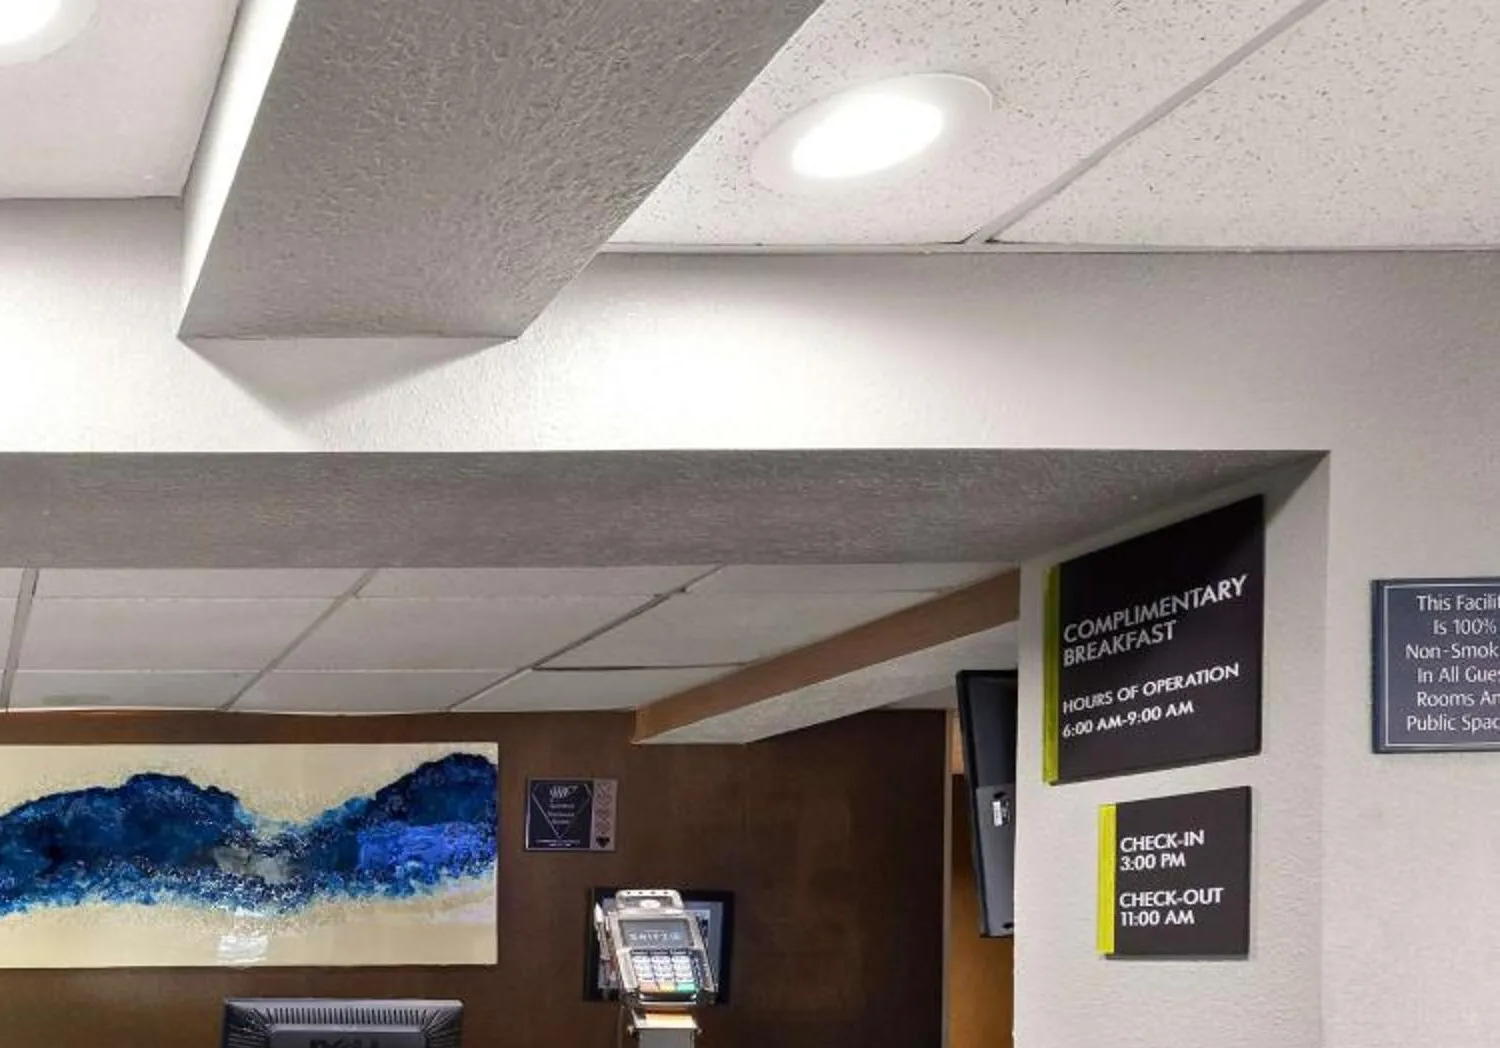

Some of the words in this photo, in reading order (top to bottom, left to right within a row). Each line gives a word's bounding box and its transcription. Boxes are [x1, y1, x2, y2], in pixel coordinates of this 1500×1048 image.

[1063, 573, 1249, 644] COMPLIMENTARY
[1416, 594, 1451, 612] This
[1433, 619, 1447, 635] Is
[1453, 617, 1497, 635] 100%
[1063, 619, 1177, 667] BREAKFAST
[1417, 667, 1433, 684] In
[1438, 665, 1459, 684] All
[1063, 691, 1113, 714] HOURS
[1117, 684, 1139, 702] OF
[1142, 662, 1240, 697] OPERATION
[1416, 690, 1475, 707] Rooms
[1062, 719, 1094, 738] 6:00
[1166, 699, 1195, 717] AM
[1406, 713, 1456, 732] Public
[1119, 829, 1205, 853] CHECK-IN
[1119, 853, 1156, 871] 3:00
[1160, 852, 1187, 868] PM
[1119, 887, 1225, 909] CHECK-OUT
[1120, 910, 1161, 927] 11:00
[1164, 909, 1195, 925] AM
